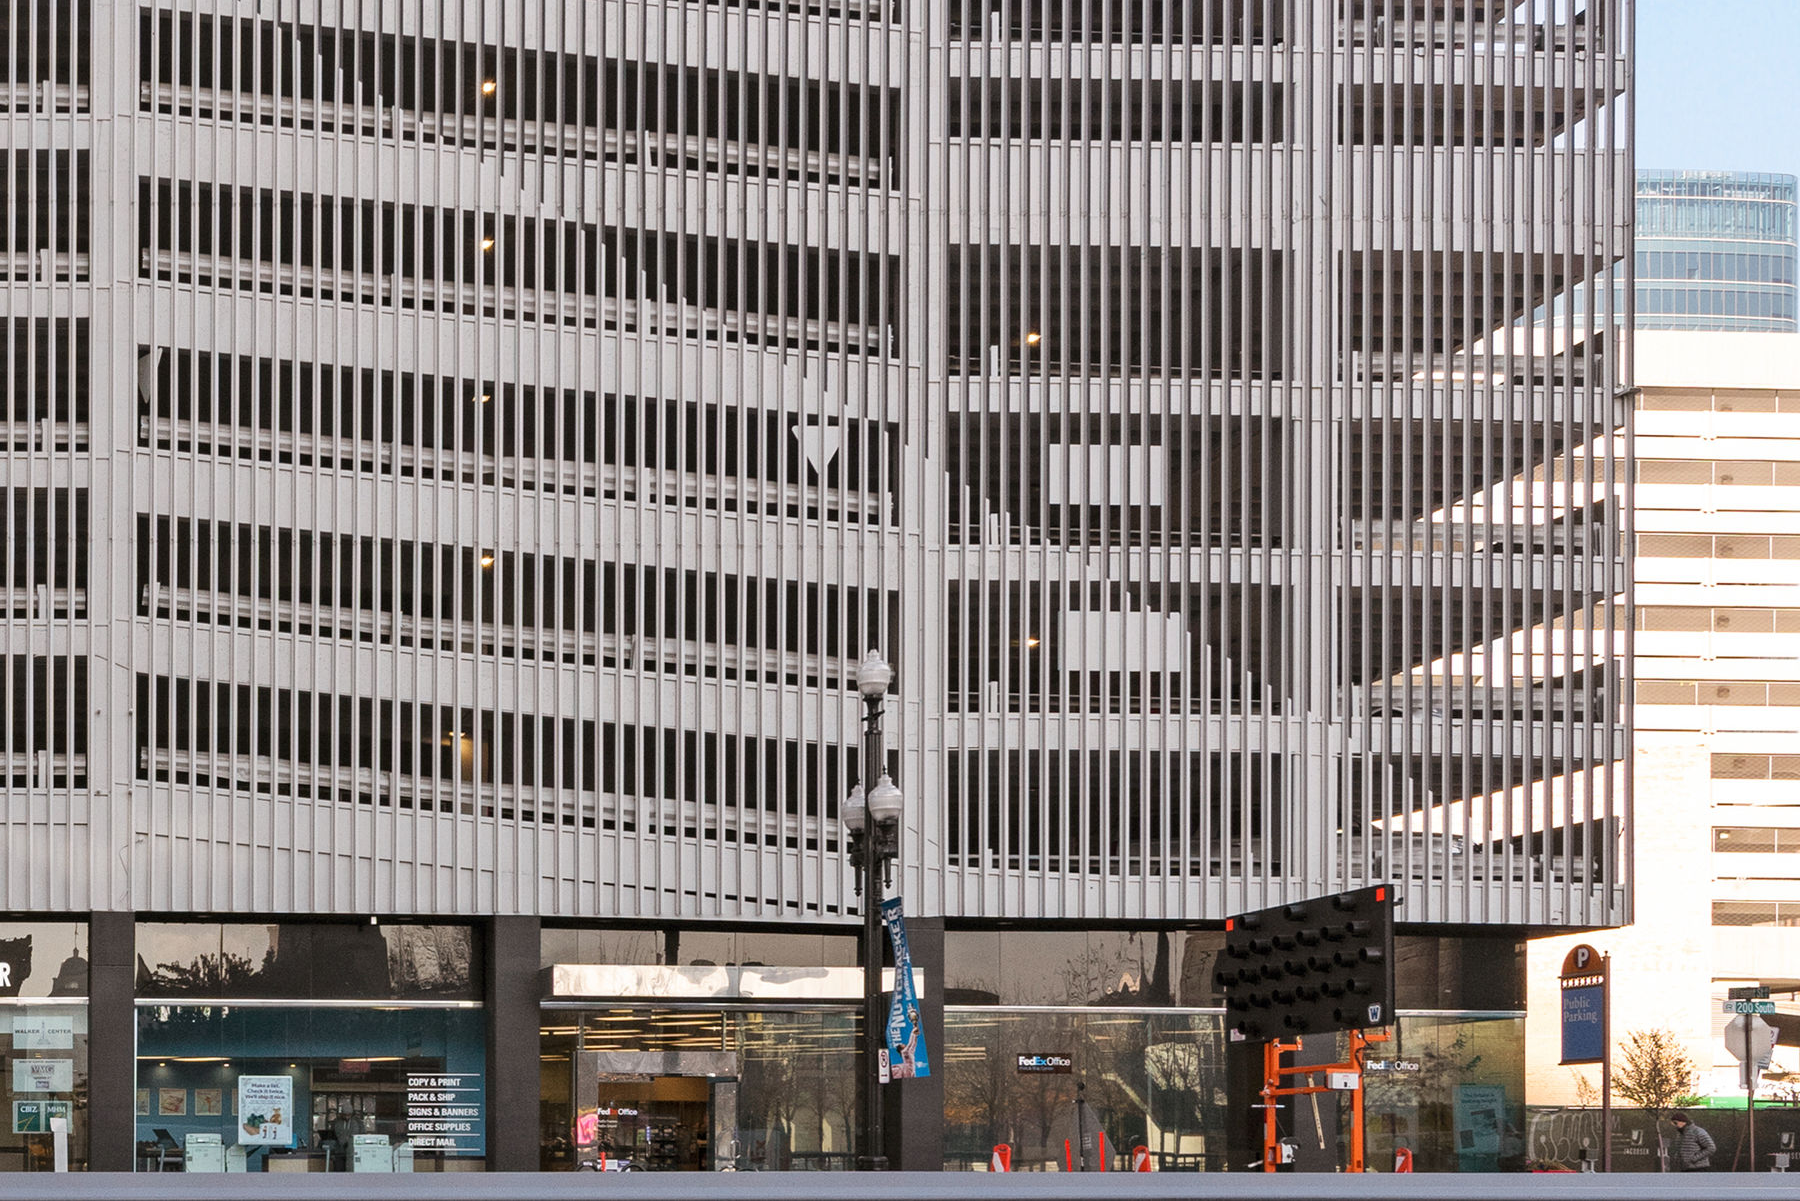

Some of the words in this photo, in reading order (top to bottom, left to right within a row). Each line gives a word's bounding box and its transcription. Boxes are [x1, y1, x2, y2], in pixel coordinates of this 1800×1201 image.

[1577, 947, 1590, 968] P
[1563, 996, 1591, 1010] Public
[1737, 1002, 1753, 1013] 200
[1755, 1002, 1775, 1014] South
[1563, 1009, 1598, 1024] Parking
[891, 1023, 903, 1049] THE
[1018, 1056, 1047, 1066] FedEx
[1047, 1056, 1071, 1066] Office
[1366, 1060, 1396, 1070] FedEx
[1395, 1060, 1419, 1071] Office
[408, 1078, 429, 1087] COPY
[429, 1078, 437, 1087] &
[437, 1078, 461, 1087] PRINT
[408, 1093, 429, 1102] PACK
[429, 1093, 437, 1102] &
[437, 1093, 456, 1102] SHIP
[20, 1105, 38, 1114] CBIZ
[47, 1105, 66, 1114] MHM
[408, 1108, 433, 1116] SIGNS
[433, 1108, 440, 1116] &
[441, 1108, 479, 1116] BANNERS
[408, 1123, 434, 1131] OFFICE
[434, 1123, 471, 1131] SUPPLIES
[408, 1138, 435, 1147] DIRECT
[436, 1138, 456, 1147] MAIL
